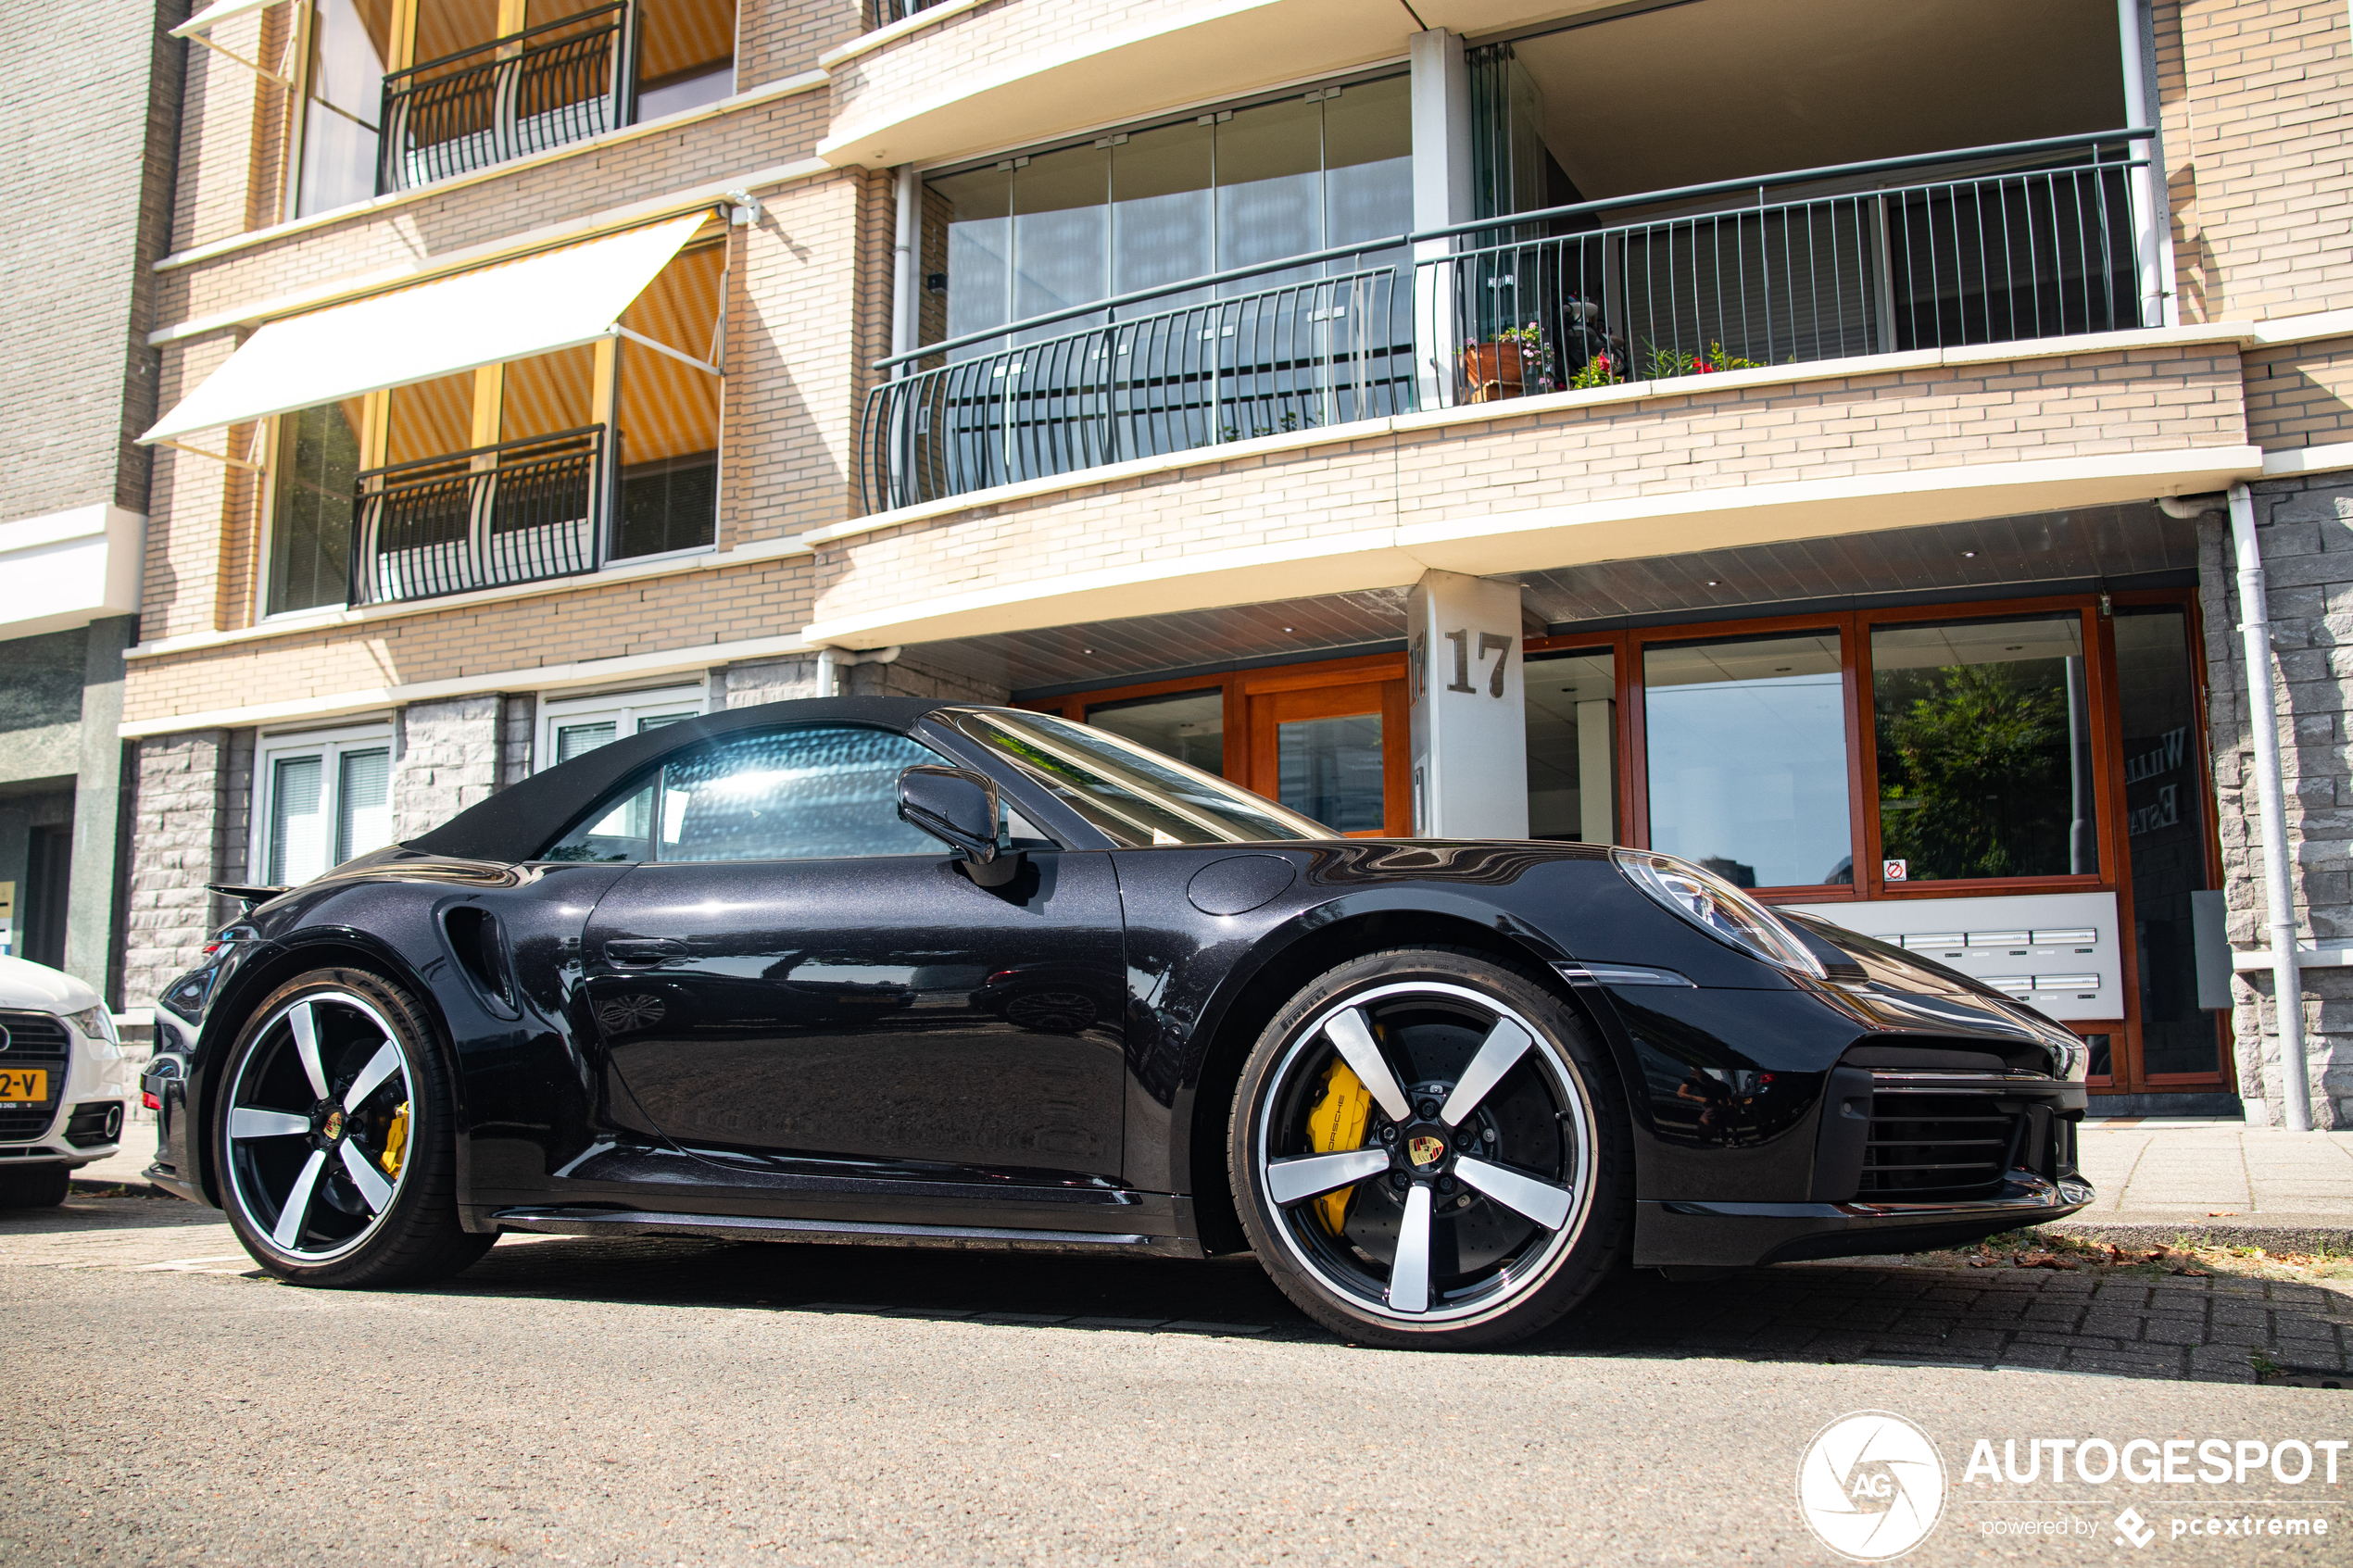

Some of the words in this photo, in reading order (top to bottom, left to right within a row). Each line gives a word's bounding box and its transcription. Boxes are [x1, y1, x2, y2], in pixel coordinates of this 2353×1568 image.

[1444, 628, 1513, 699] 17
[371, 989, 416, 1041] ZERO
[1279, 985, 1328, 1032] PIRELLI
[1327, 1094, 1345, 1151] ORSCHE
